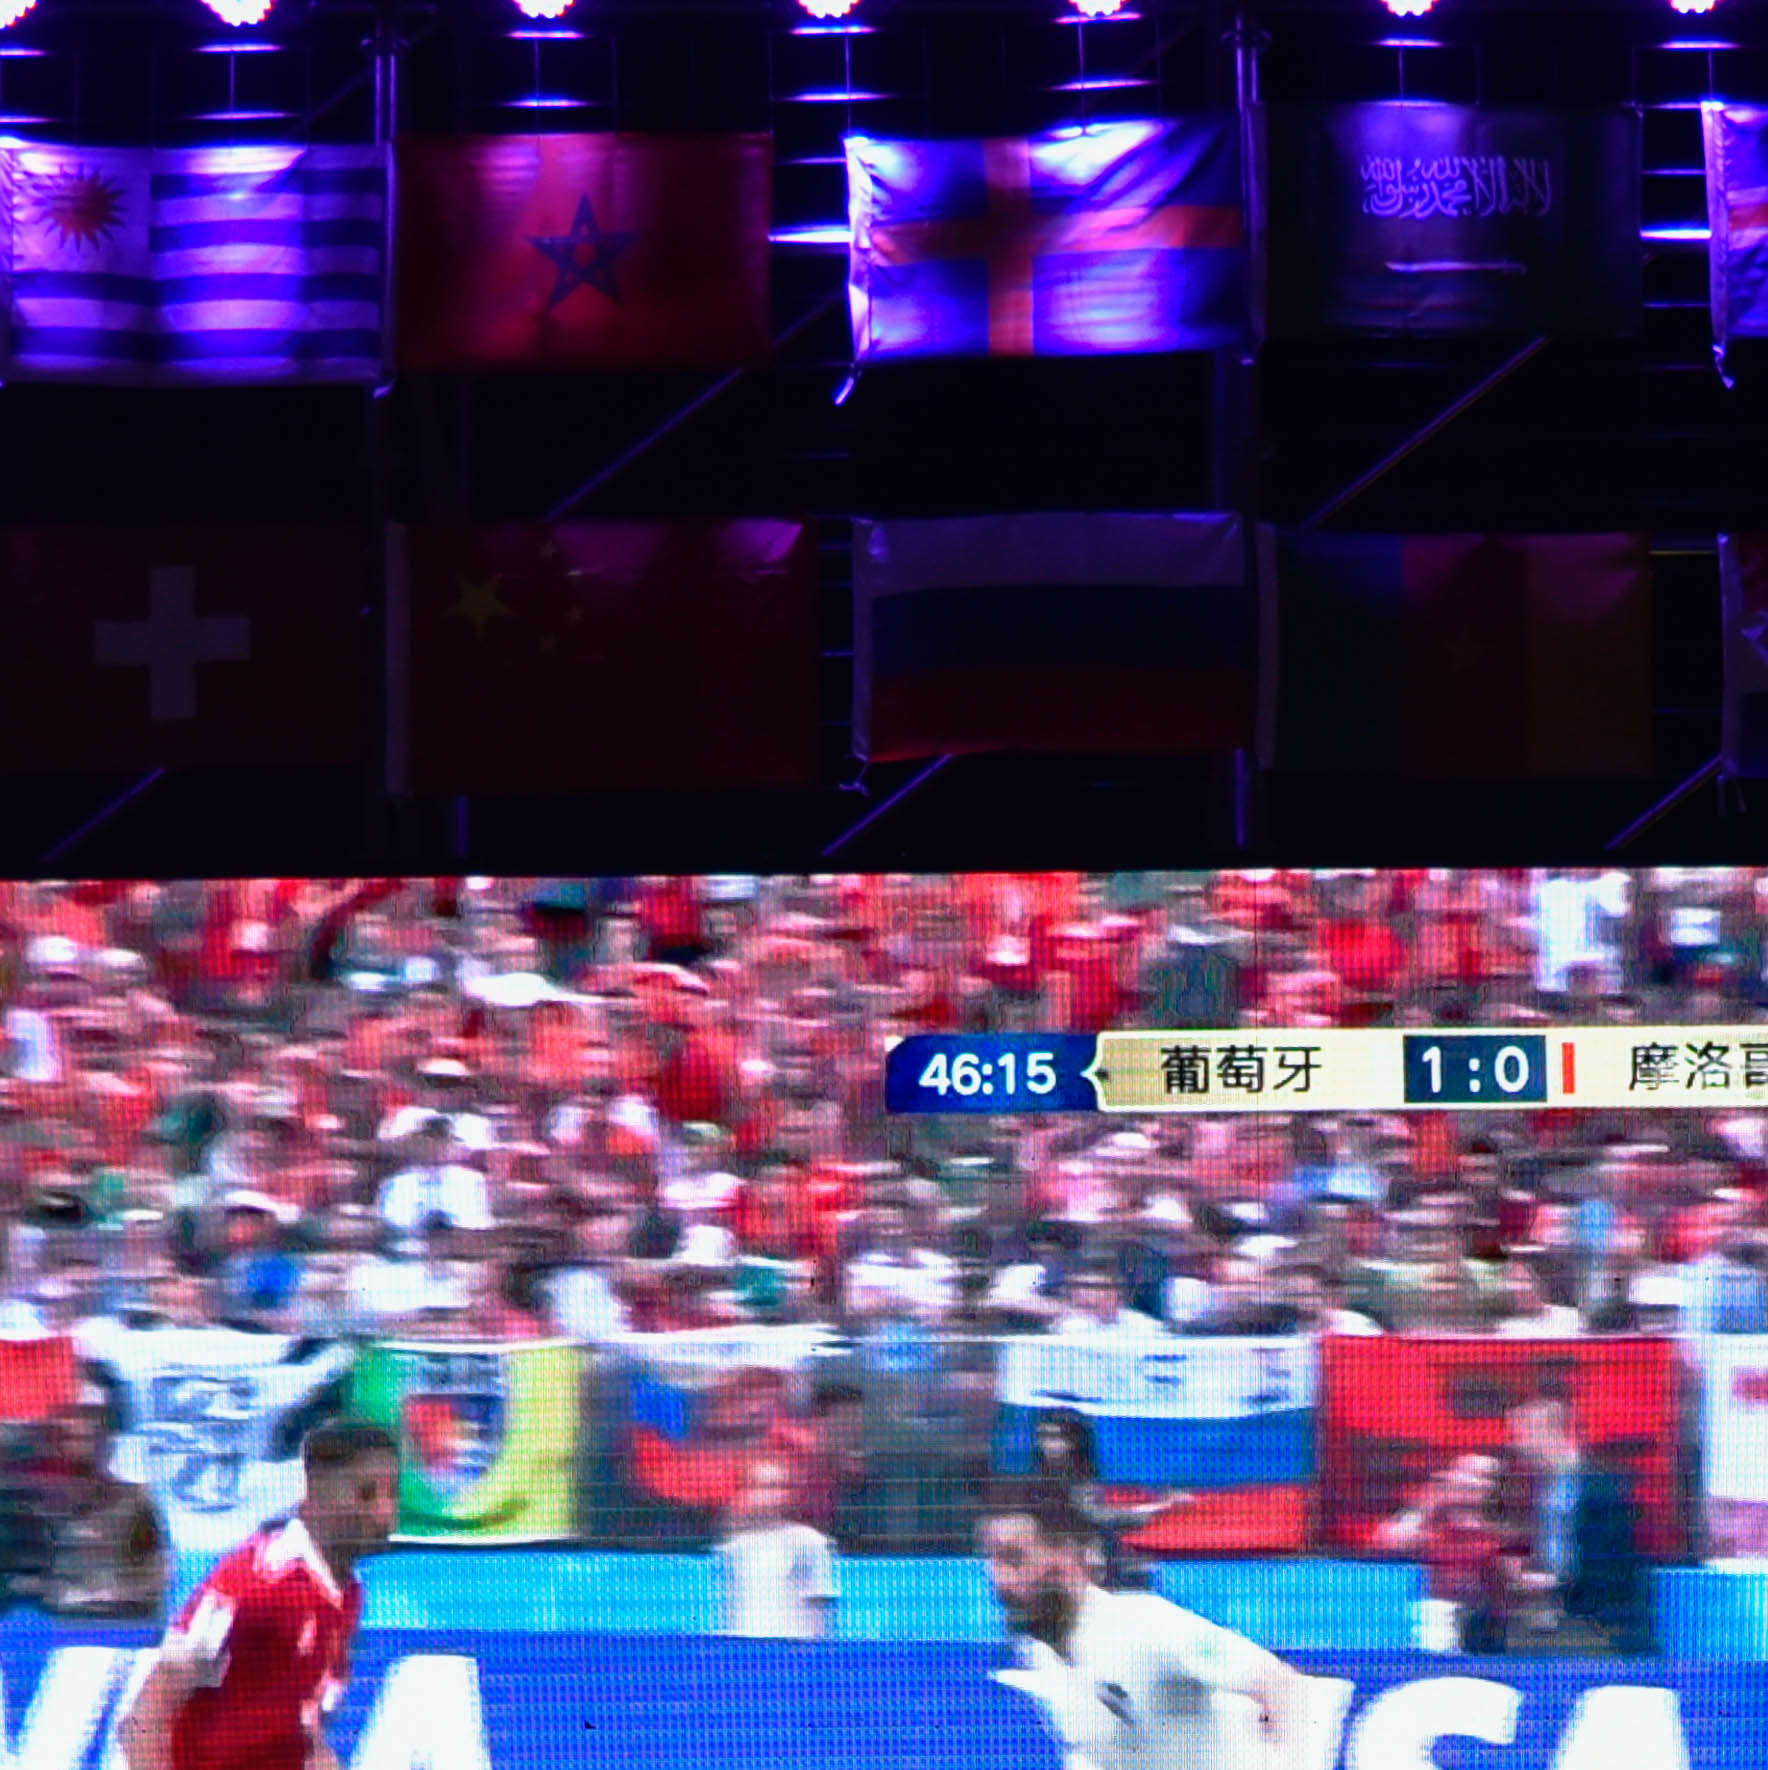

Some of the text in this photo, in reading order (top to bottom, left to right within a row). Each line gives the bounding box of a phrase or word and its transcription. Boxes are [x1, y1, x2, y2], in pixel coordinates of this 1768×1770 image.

[918, 1051, 1057, 1095] 46:15
[1160, 1044, 1323, 1095] 葡萄牙
